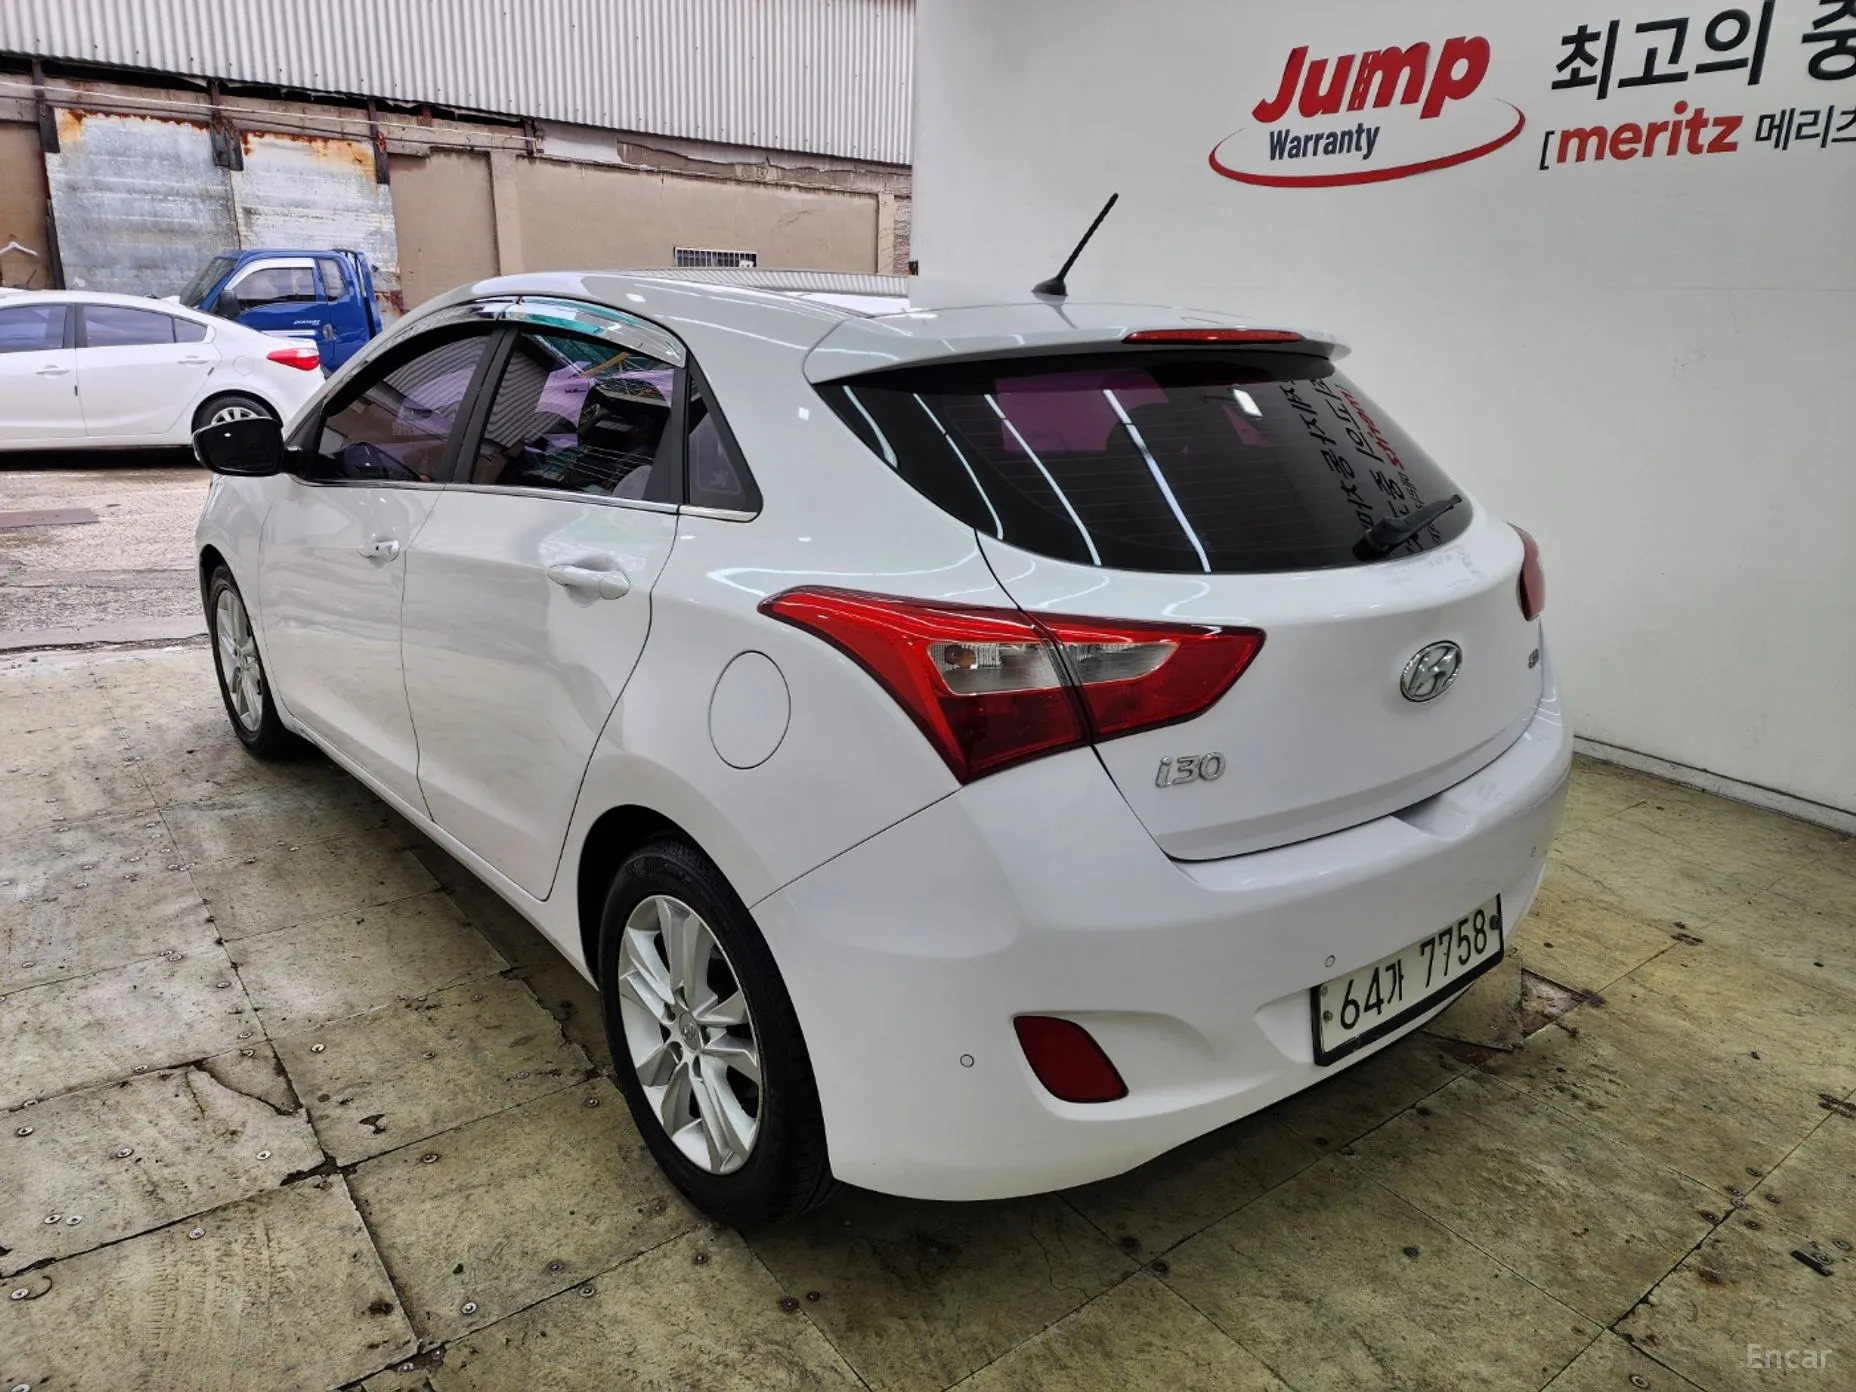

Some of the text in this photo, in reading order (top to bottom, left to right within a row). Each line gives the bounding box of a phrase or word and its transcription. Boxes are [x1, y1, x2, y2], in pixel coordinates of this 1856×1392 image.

[1252, 35, 1491, 123] Jump
[1551, 0, 1775, 100] 최고의
[1269, 122, 1380, 162] Warranty
[1154, 751, 1226, 789] i30
[1340, 908, 1487, 1030] 64가 7758
